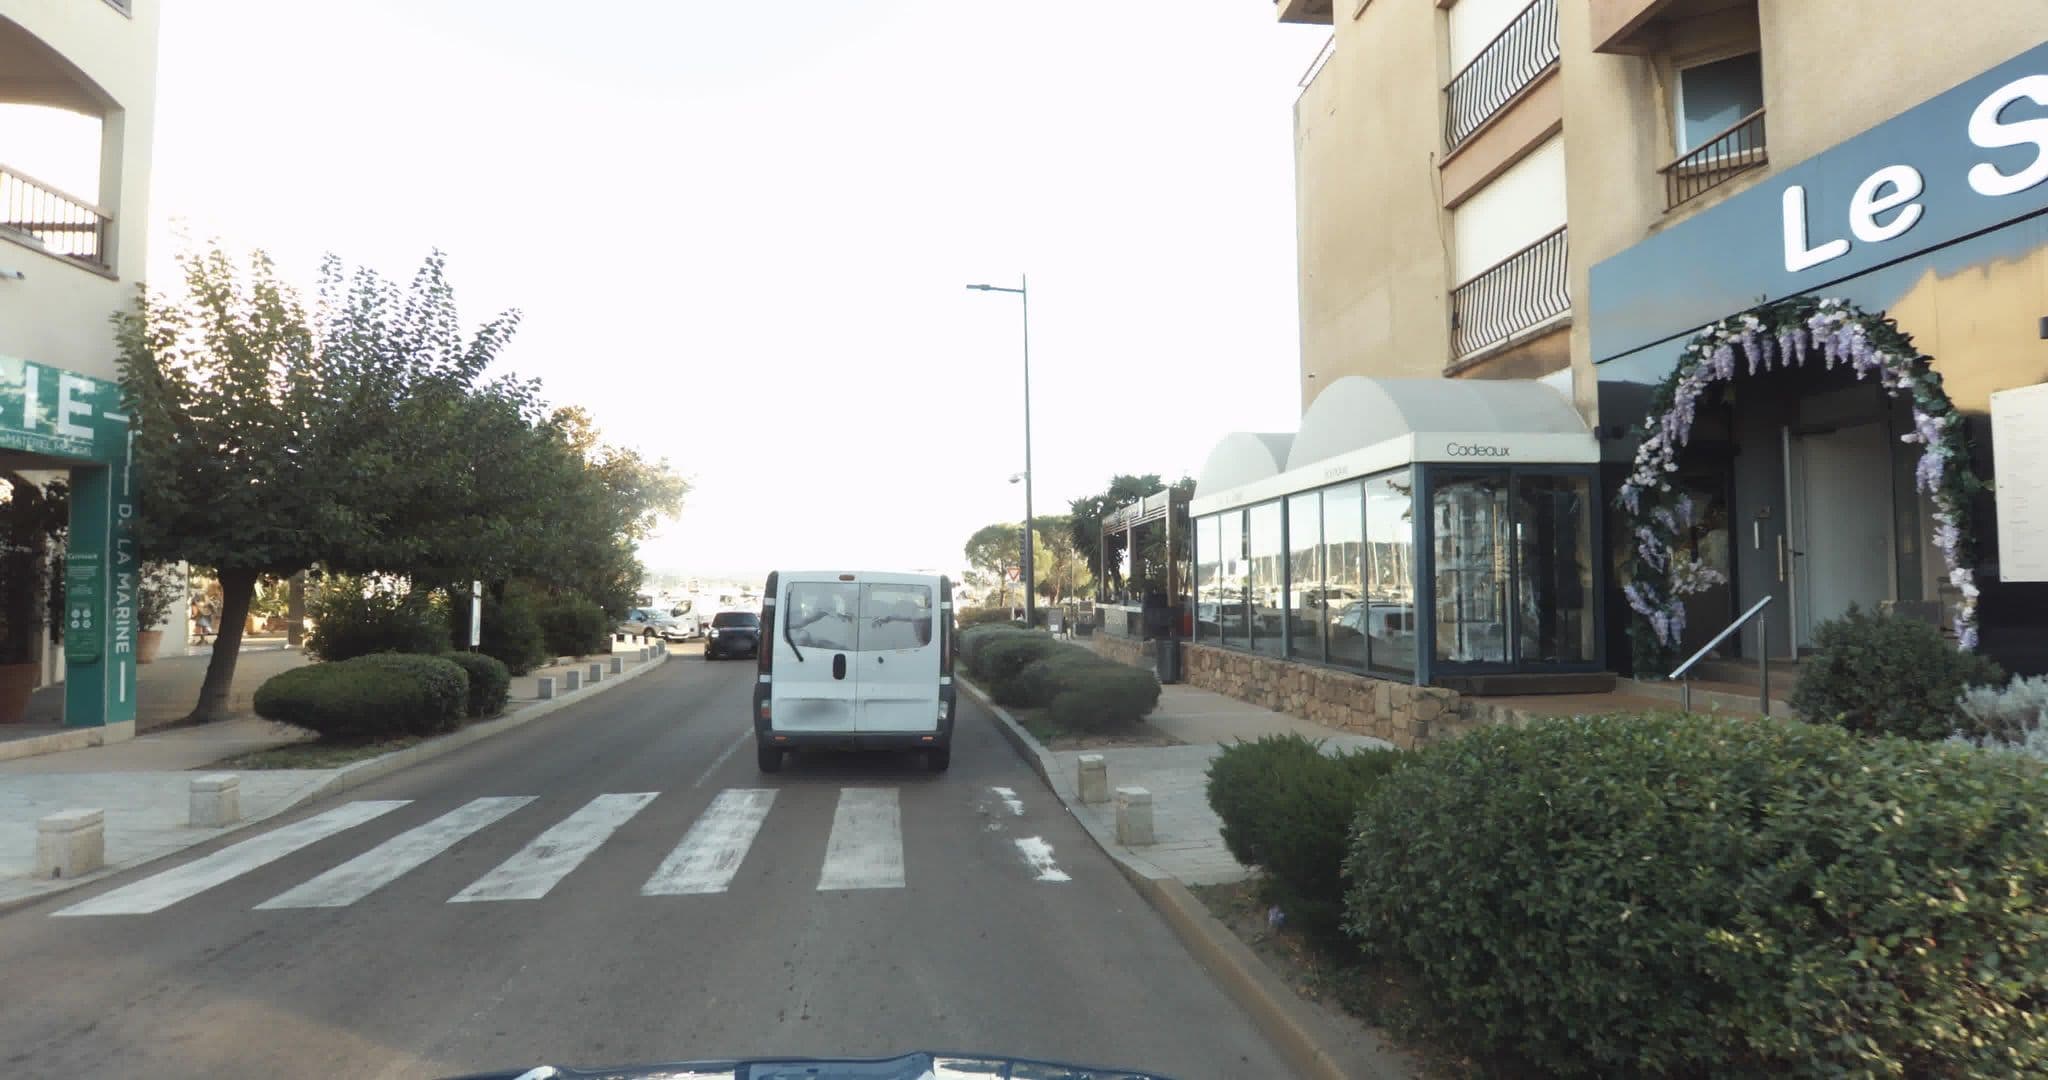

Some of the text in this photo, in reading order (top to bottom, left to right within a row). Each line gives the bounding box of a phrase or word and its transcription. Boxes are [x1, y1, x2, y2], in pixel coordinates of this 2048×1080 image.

[1782, 164, 1925, 273] Le
[0, 364, 96, 440] IE
[1446, 442, 1510, 457] Cadeaux
[117, 538, 132, 565] LA
[115, 572, 131, 654] MARINE
